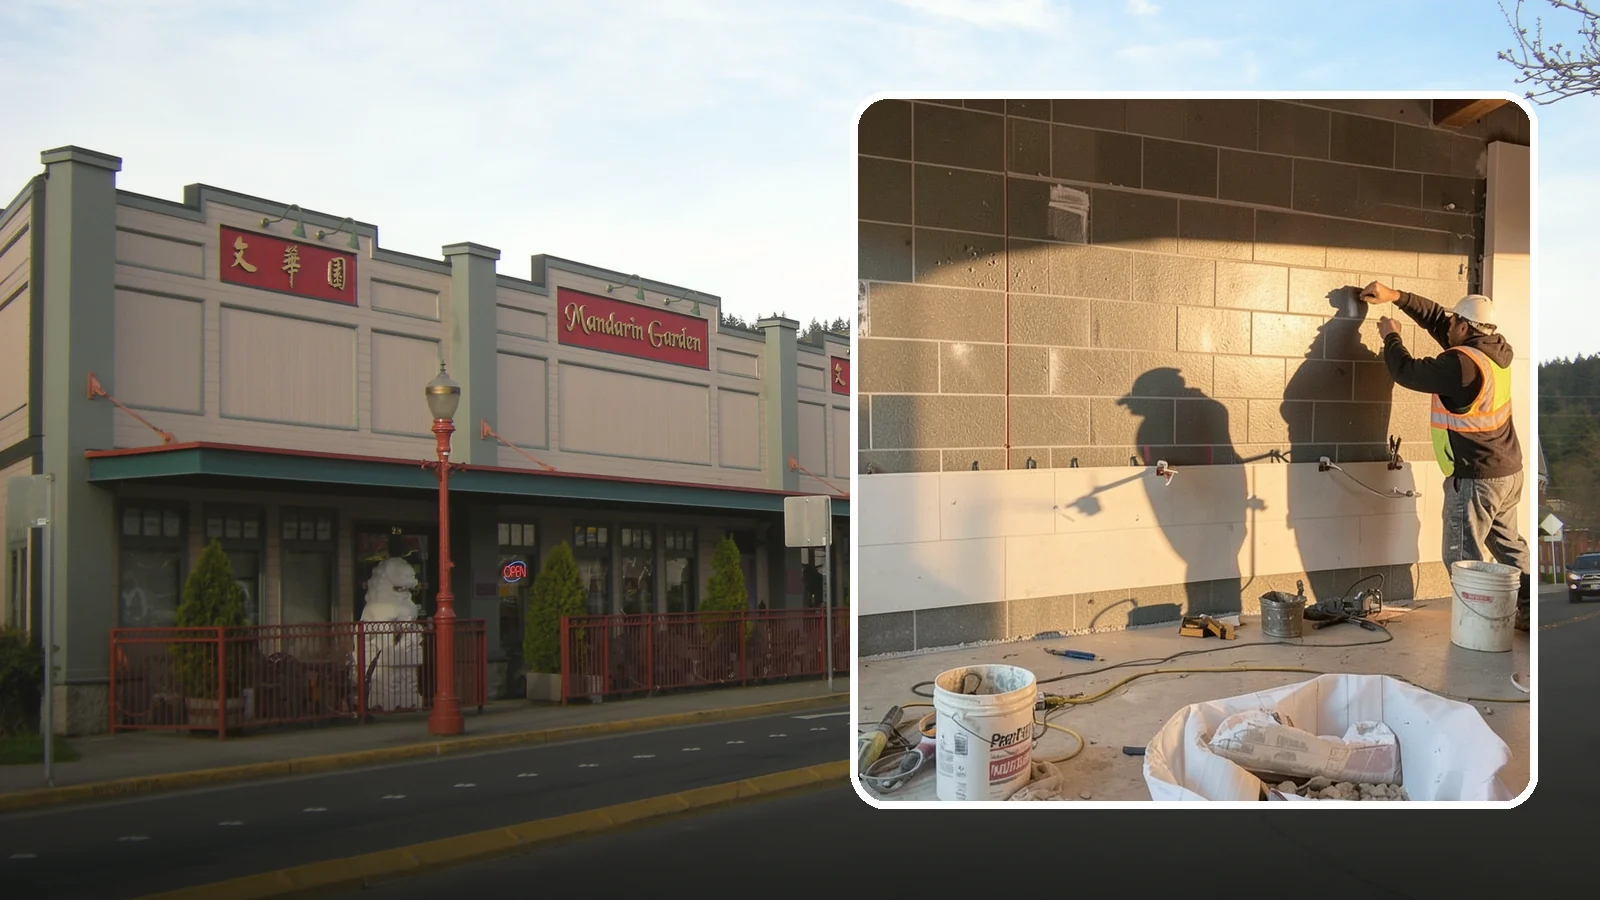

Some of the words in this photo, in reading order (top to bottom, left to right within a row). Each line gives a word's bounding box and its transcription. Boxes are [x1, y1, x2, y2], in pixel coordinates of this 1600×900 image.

[230, 235, 346, 291] 文華園
[564, 302, 644, 341] Mandarin
[648, 320, 702, 352] Garden
[835, 363, 847, 387] 文
[503, 565, 527, 578] OPEN
